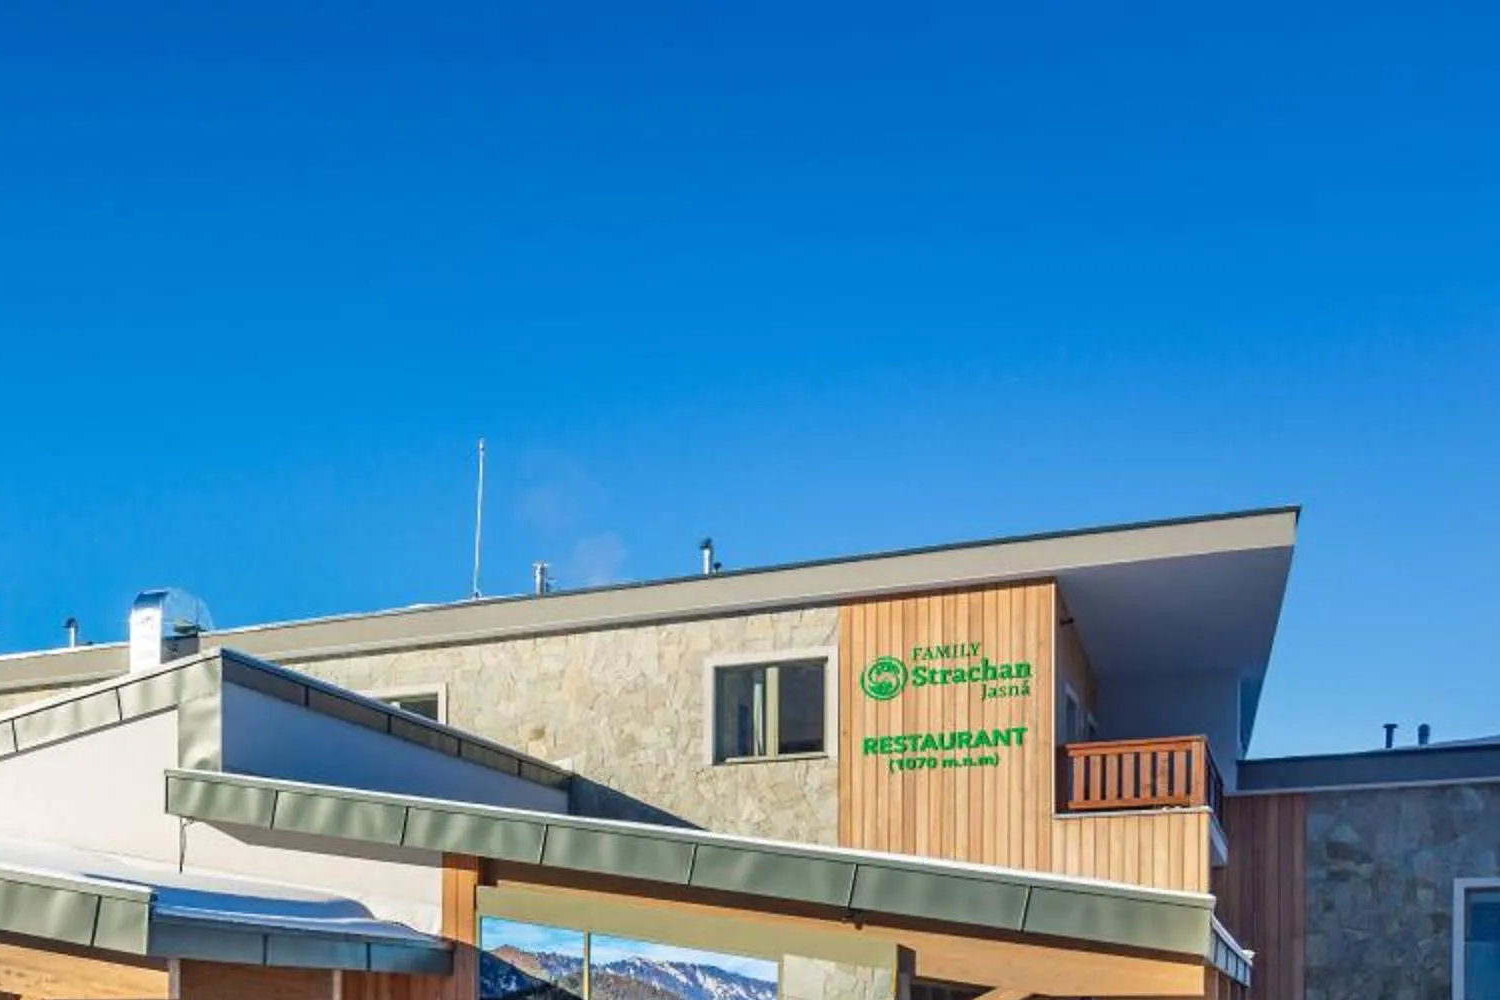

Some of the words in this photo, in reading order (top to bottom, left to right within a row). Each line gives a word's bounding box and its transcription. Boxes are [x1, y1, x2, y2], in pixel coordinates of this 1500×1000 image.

[911, 641, 980, 661] FAMILY
[911, 657, 1031, 687] Strachan
[863, 726, 1028, 755] RESTAURANT
